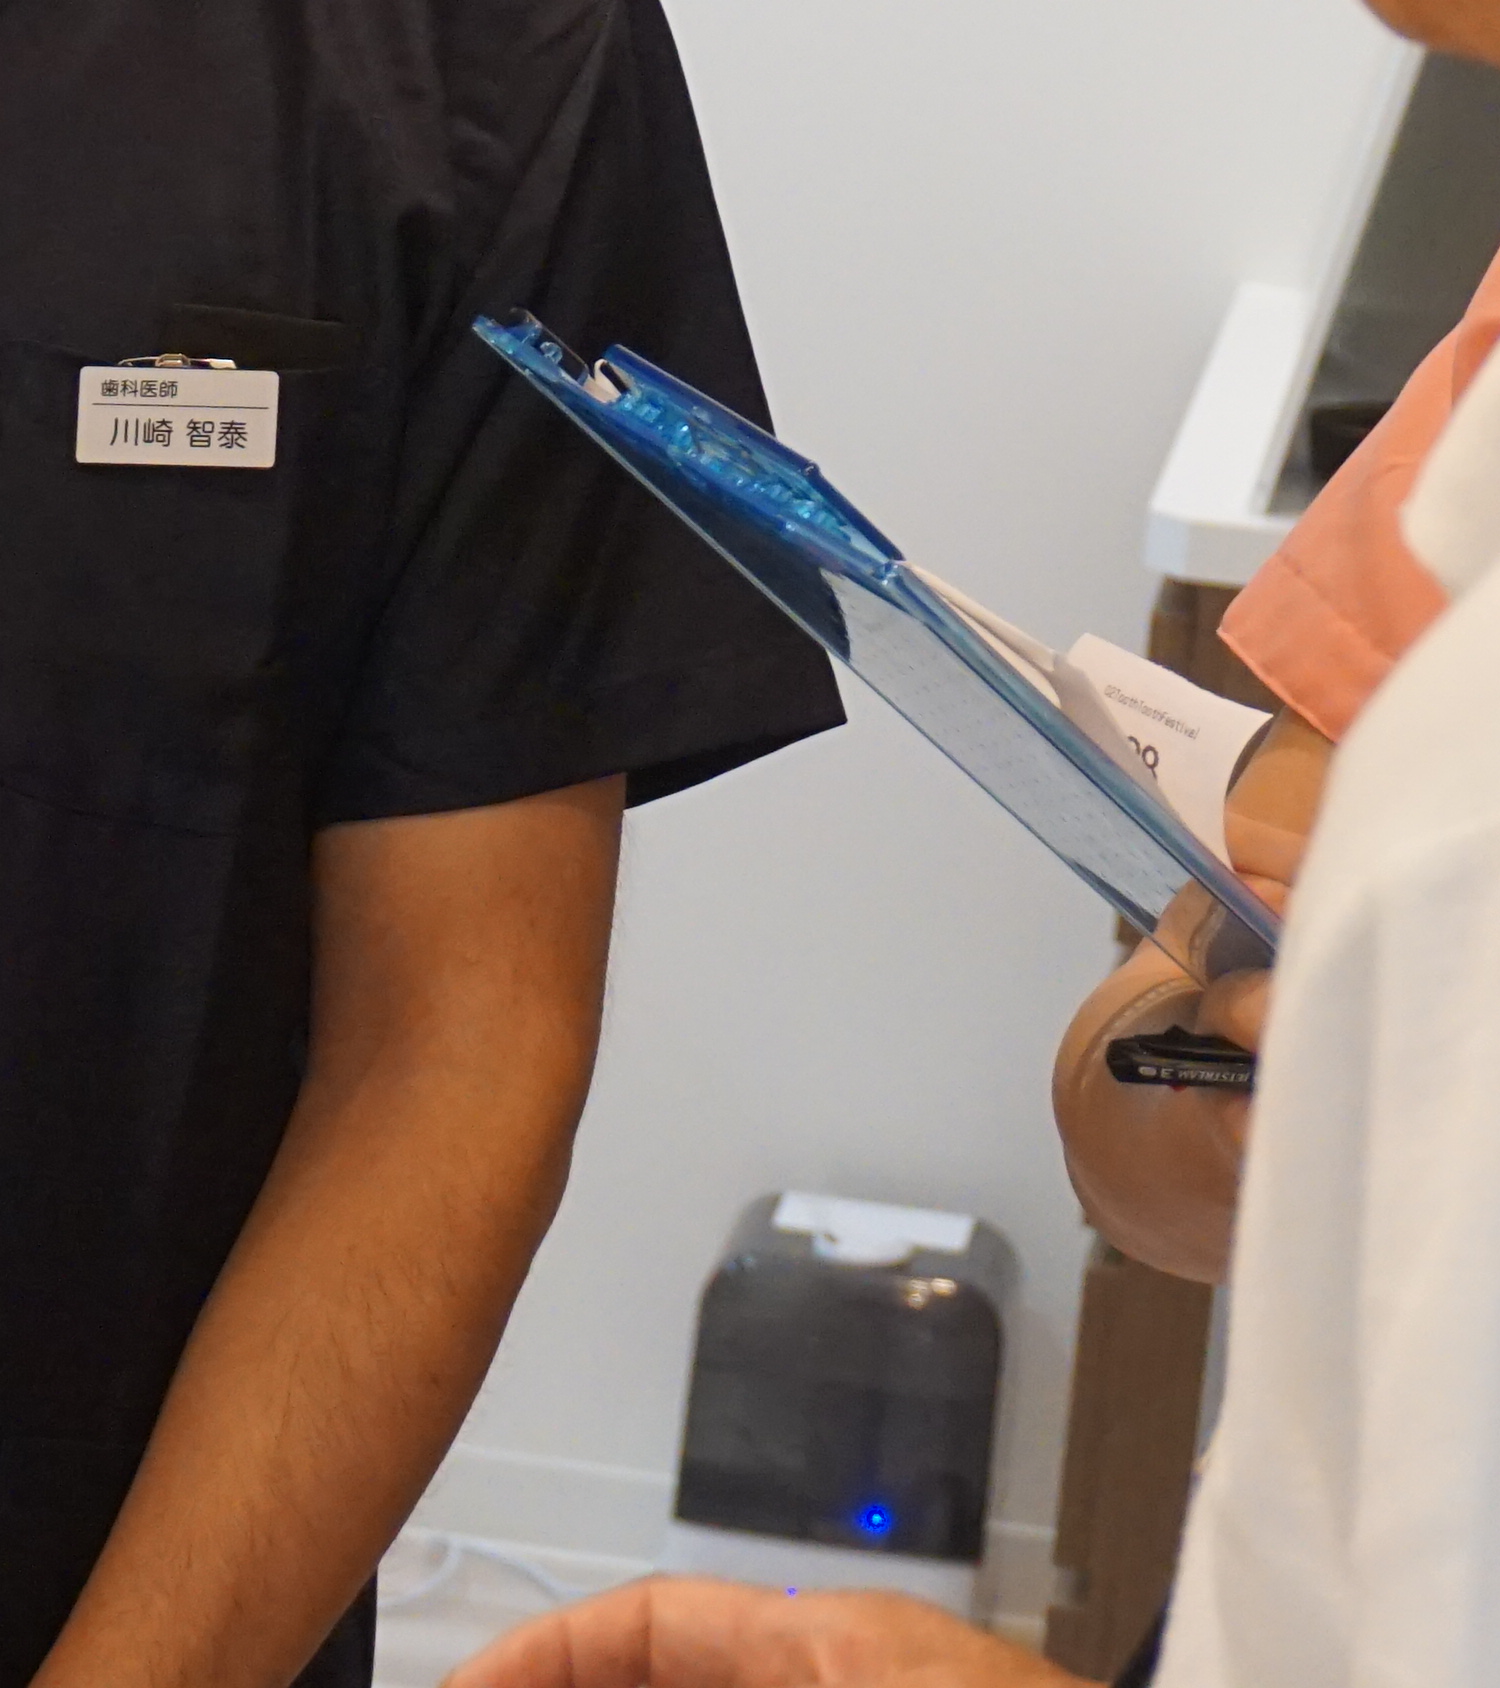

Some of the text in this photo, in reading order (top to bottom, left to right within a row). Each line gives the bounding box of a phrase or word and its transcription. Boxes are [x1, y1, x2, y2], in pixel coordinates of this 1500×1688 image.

[100, 378, 179, 399] 歯科医師
[109, 416, 249, 449] 川崎 智泰
